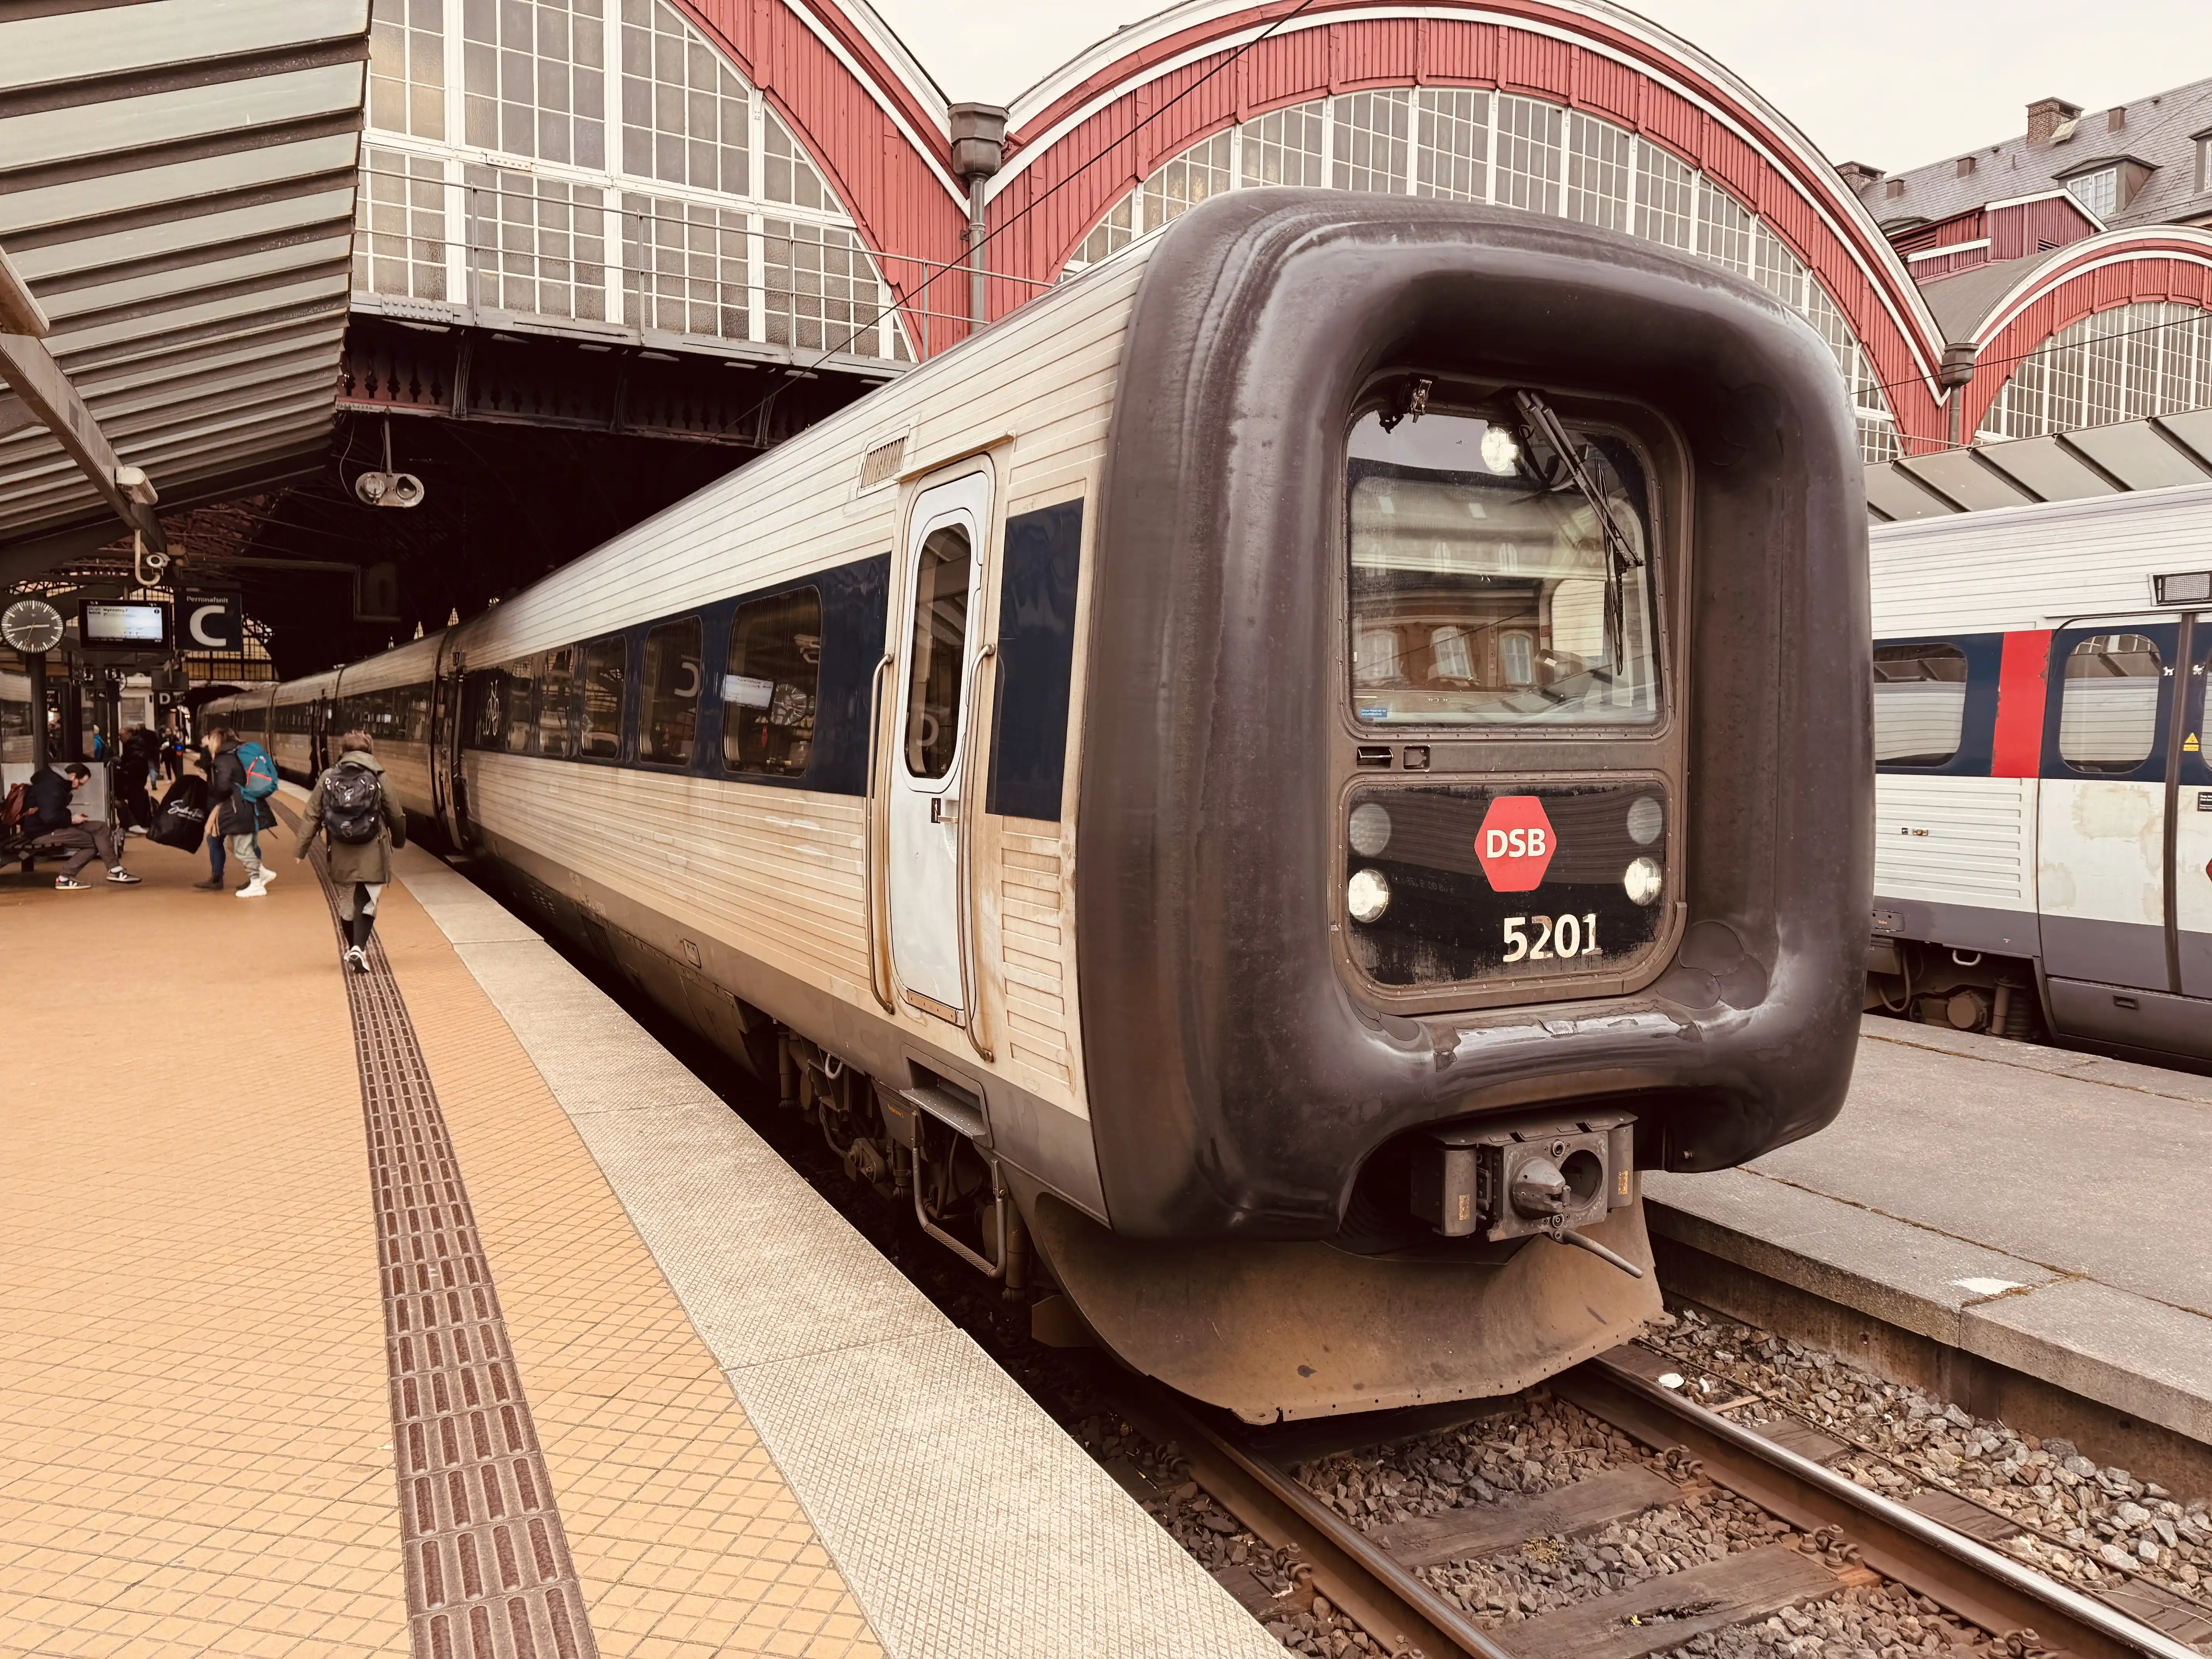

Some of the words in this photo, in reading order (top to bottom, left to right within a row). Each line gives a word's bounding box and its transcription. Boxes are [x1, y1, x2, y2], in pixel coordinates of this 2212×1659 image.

[190, 605, 226, 647] C
[159, 692, 170, 704] D
[1487, 828, 1546, 858] DSB
[1503, 913, 1603, 962] 5201
